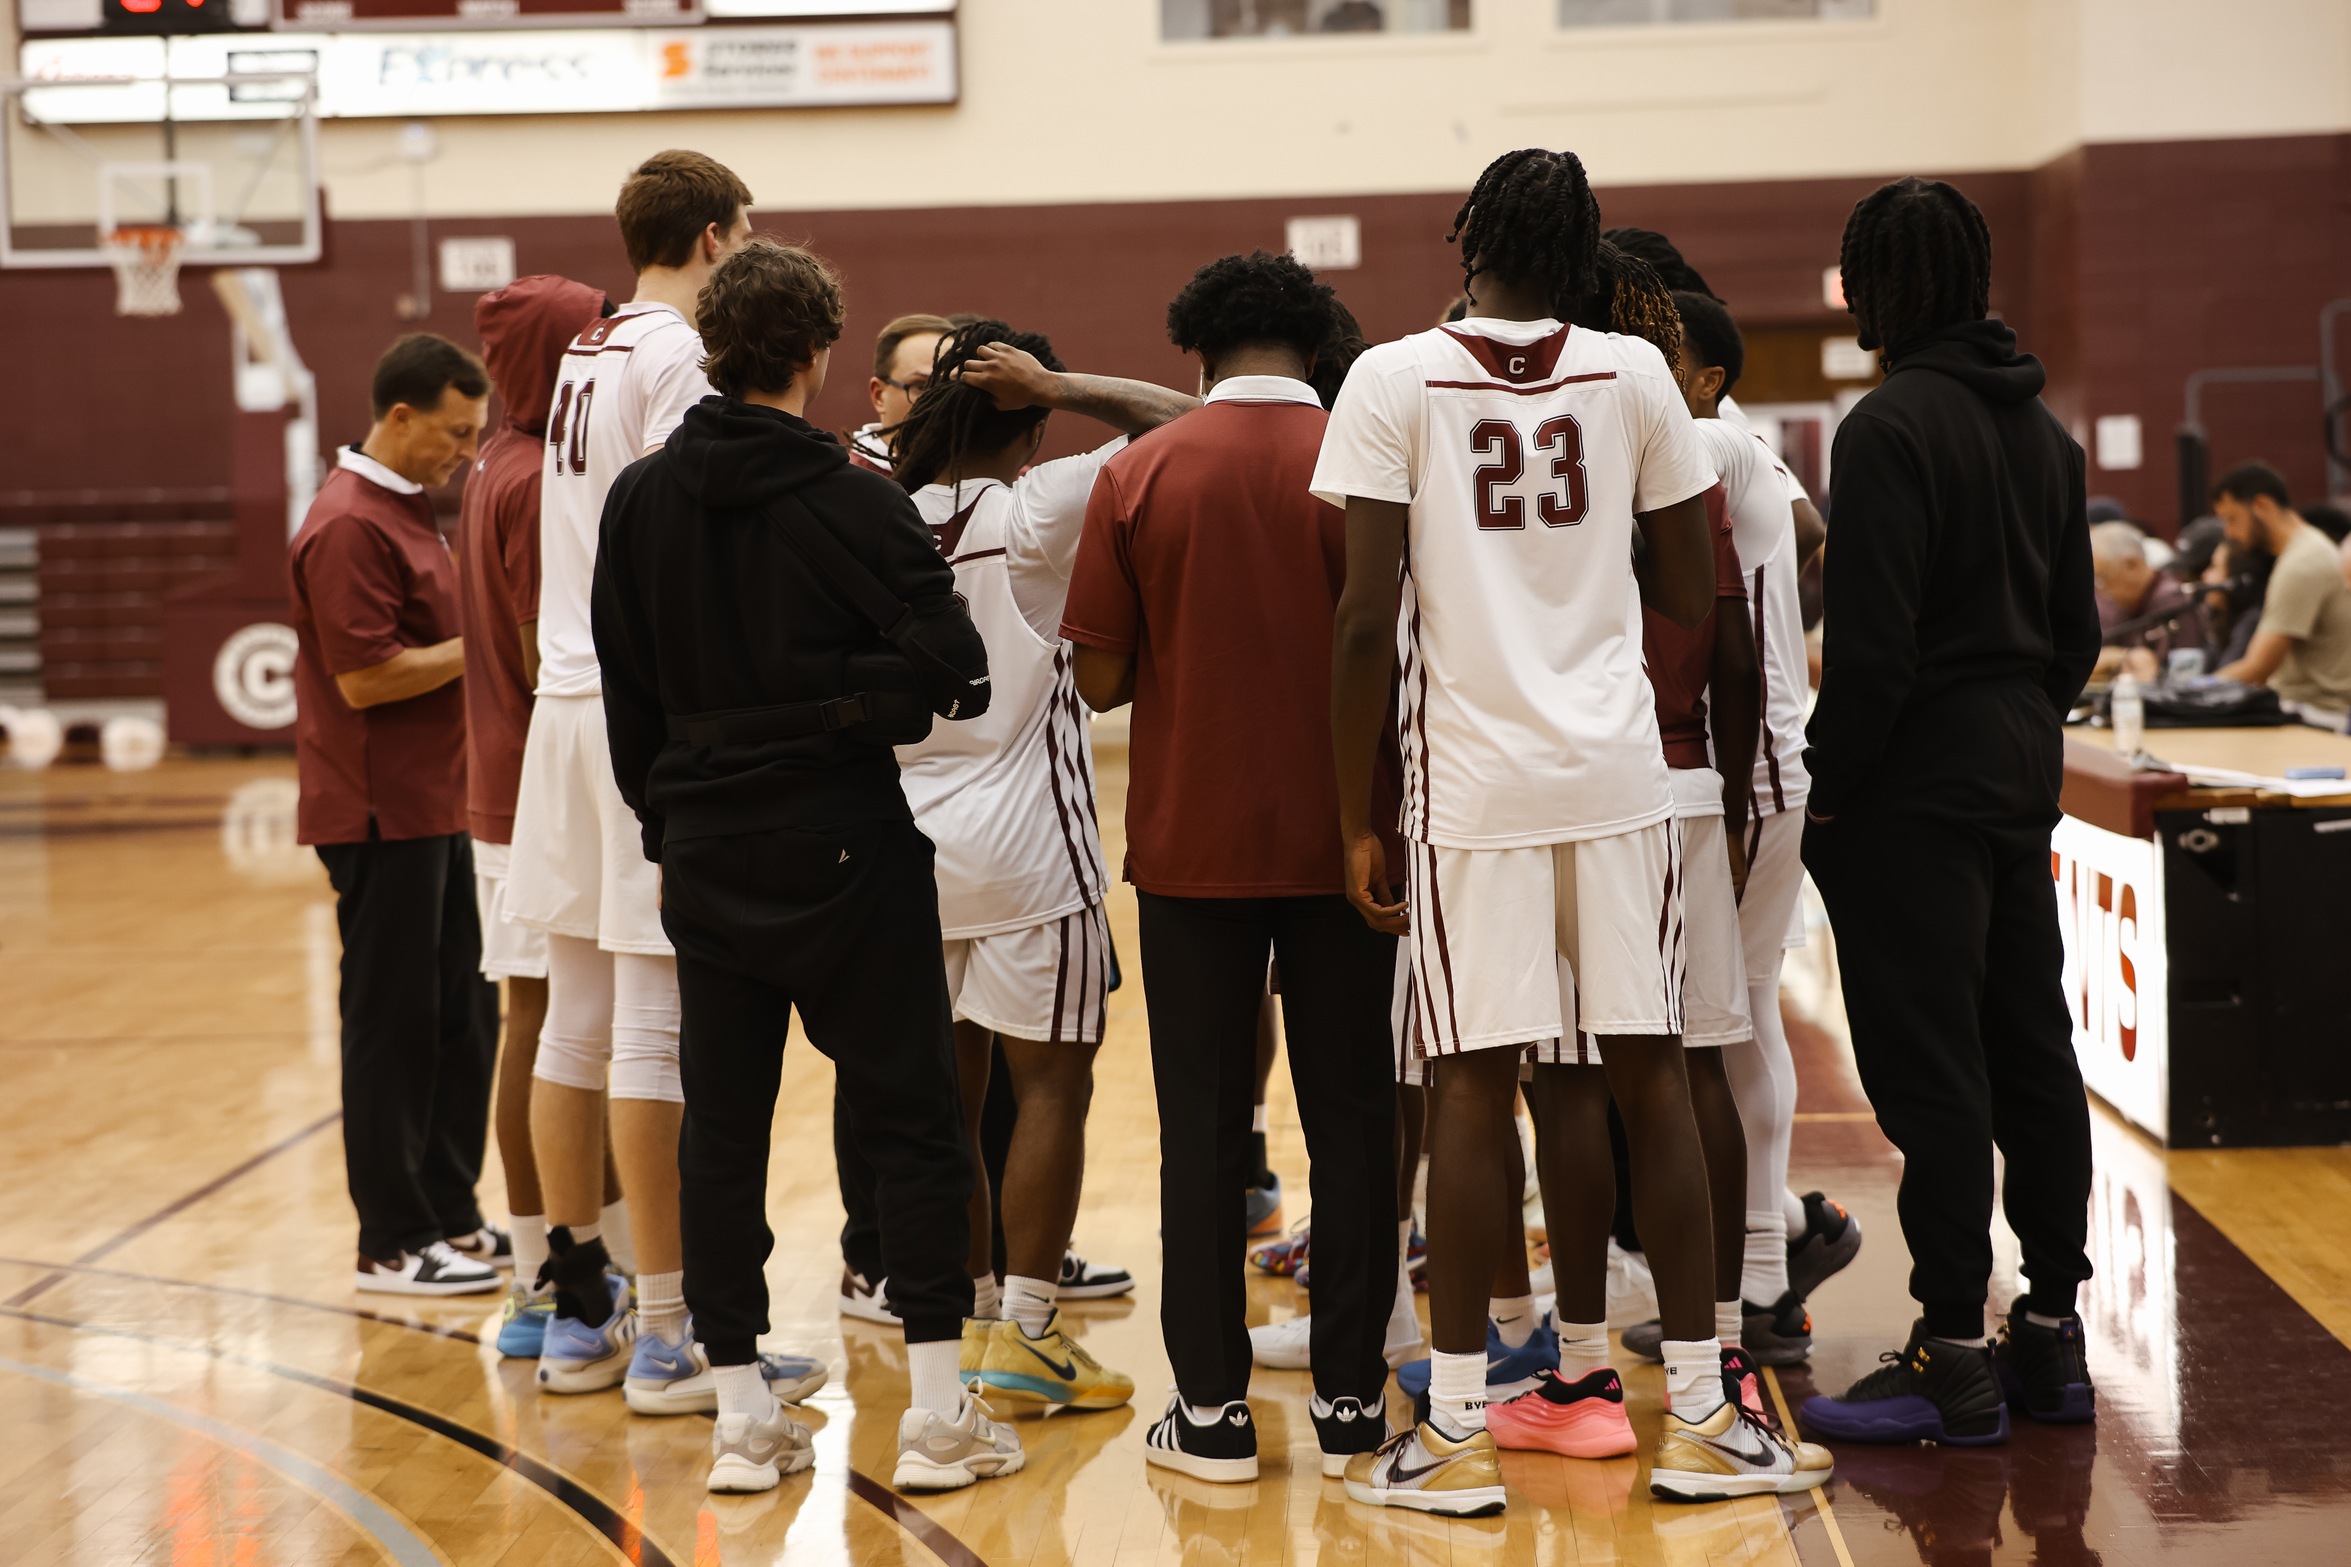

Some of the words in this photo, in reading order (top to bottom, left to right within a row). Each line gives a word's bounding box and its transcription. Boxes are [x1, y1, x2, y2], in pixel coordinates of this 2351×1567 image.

[590, 326, 605, 342] C
[1509, 357, 1525, 375] C
[1470, 414, 1589, 531] 23
[2051, 851, 2138, 1062] NTS
